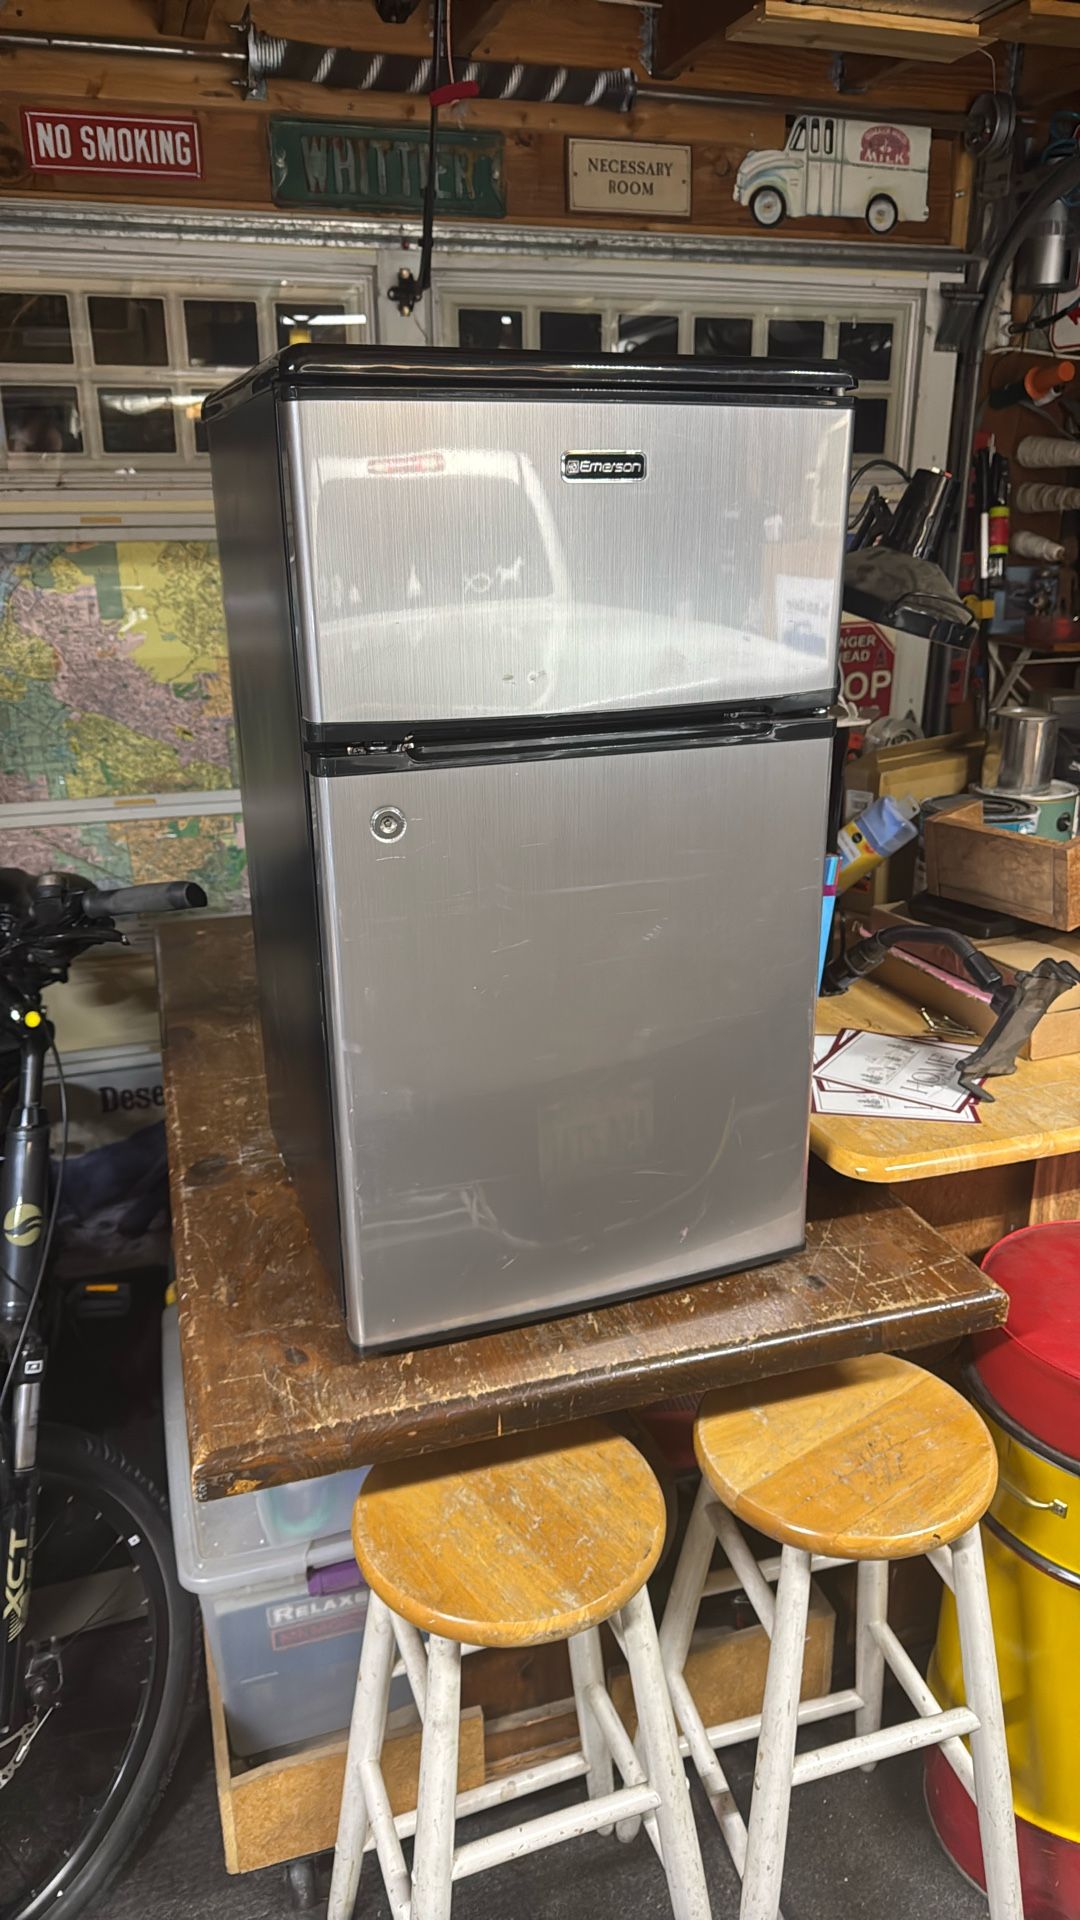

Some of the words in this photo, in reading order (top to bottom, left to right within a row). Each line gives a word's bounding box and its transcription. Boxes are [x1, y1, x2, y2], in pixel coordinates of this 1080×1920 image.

[35, 121, 72, 159] NO
[79, 124, 192, 166] SMOKING
[301, 135, 477, 199] WHITTIER
[587, 157, 673, 177] NECESSARY
[863, 148, 905, 164] MILK
[608, 179, 654, 196] ROOM
[579, 460, 642, 474] Emerson
[839, 633, 877, 650] NGER
[840, 648, 871, 664] EAD
[843, 669, 893, 702] OP
[899, 1052, 959, 1095] HOME
[99, 1085, 164, 1112] Dese
[2, 1527, 28, 1620] XCT
